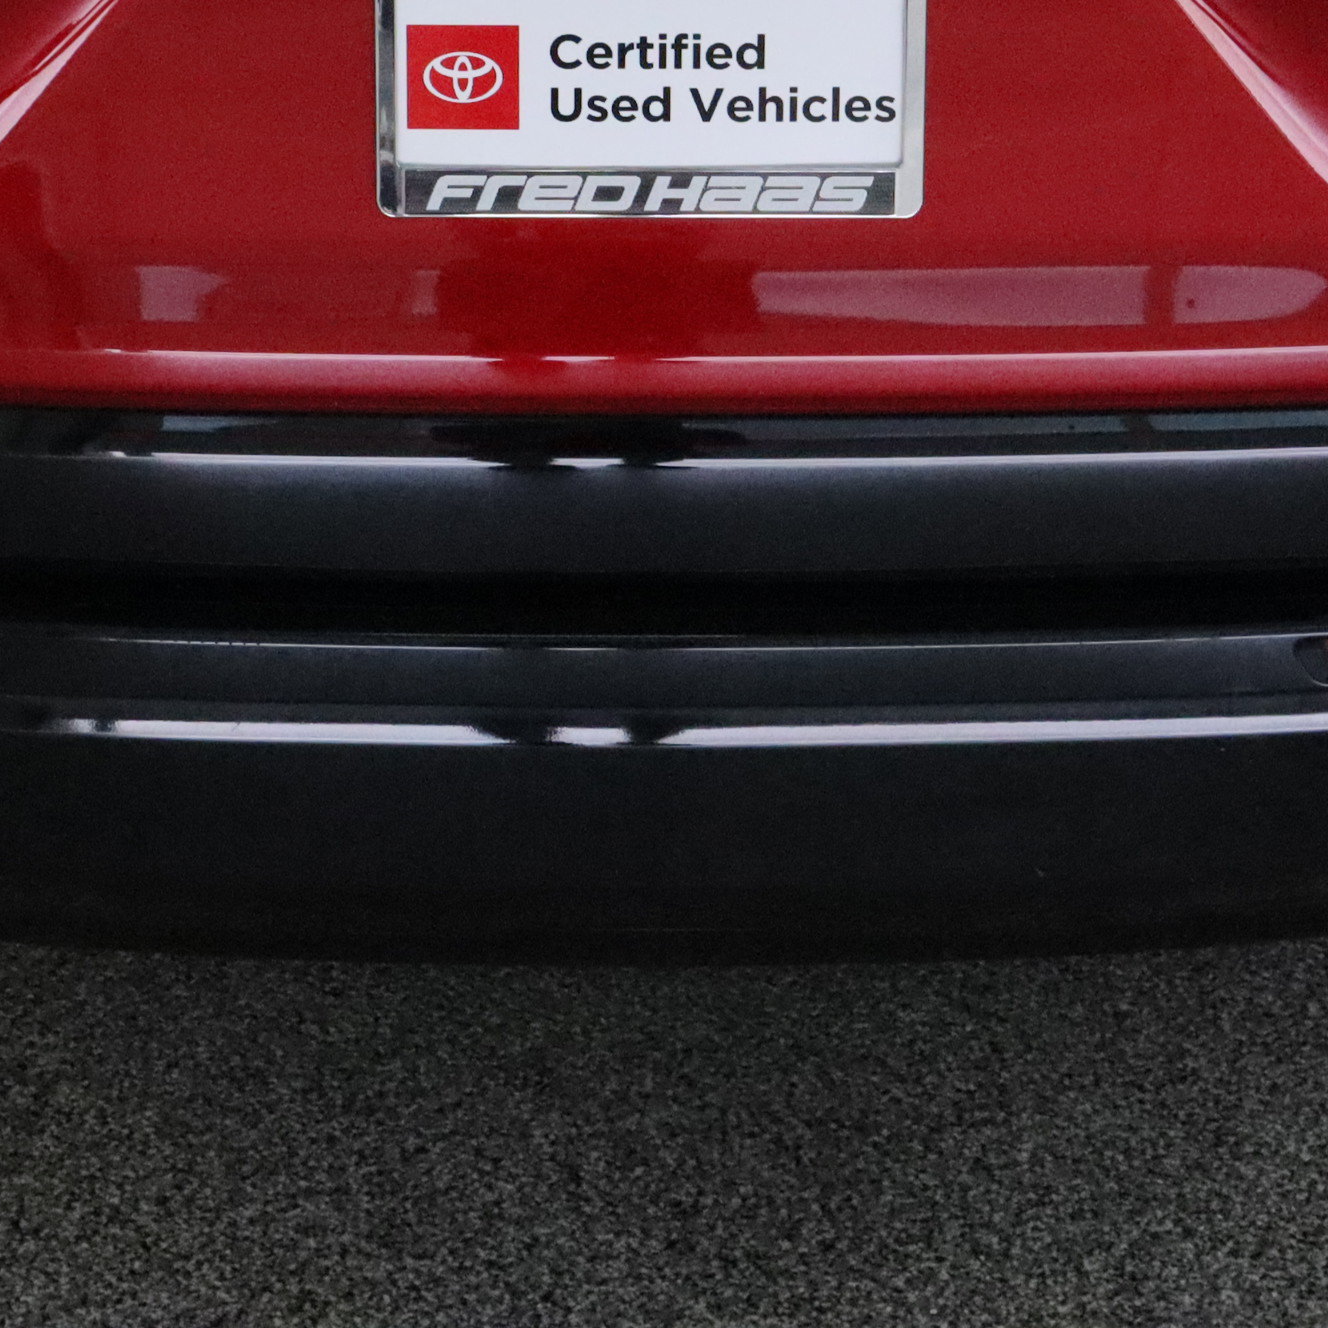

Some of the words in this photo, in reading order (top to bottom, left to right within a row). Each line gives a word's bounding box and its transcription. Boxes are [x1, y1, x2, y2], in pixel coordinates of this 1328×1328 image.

[549, 33, 766, 70] Certified
[549, 86, 672, 123] Used
[690, 86, 897, 123] Vehicles
